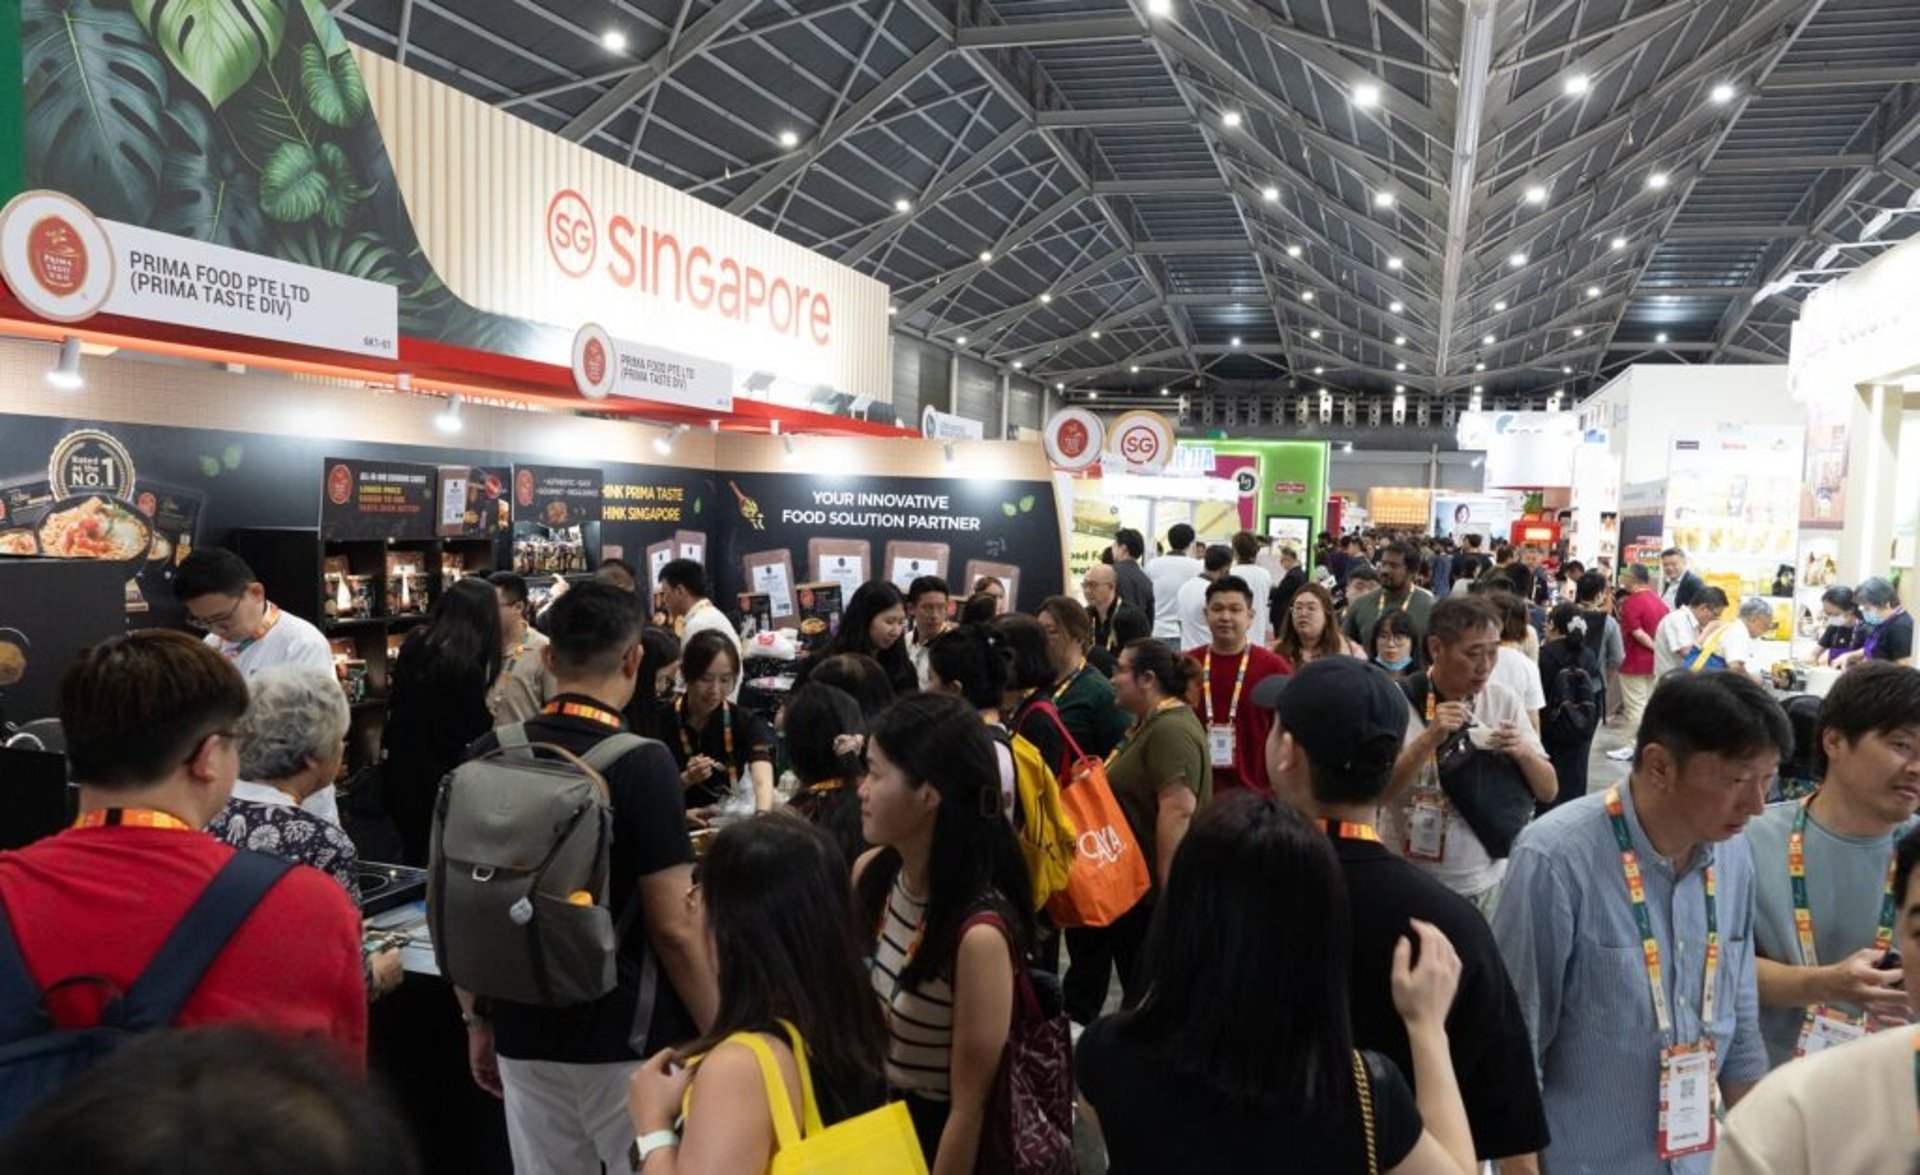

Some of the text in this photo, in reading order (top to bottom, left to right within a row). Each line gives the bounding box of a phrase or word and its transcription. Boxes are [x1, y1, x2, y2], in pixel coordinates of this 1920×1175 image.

[555, 213, 591, 254] SG
[44, 254, 72, 267] PRIMA
[130, 250, 310, 303] PRIMA FOOD PTE LTD
[131, 271, 292, 321] (PRIMA TASTE DIV)
[620, 353, 695, 380] PRIMA FOOD PTE LTD
[621, 367, 687, 391] (PRIMA TASTE DIV)
[1126, 435, 1153, 453] SG
[602, 484, 625, 499] HINK
[625, 485, 655, 500] PRIMA
[656, 487, 683, 501] TASTE
[813, 491, 949, 510] YOUR INNOVATIVE
[602, 506, 681, 522] HINK SINGAPORE
[782, 509, 980, 531] FOOD SOLUTION PARTNER
